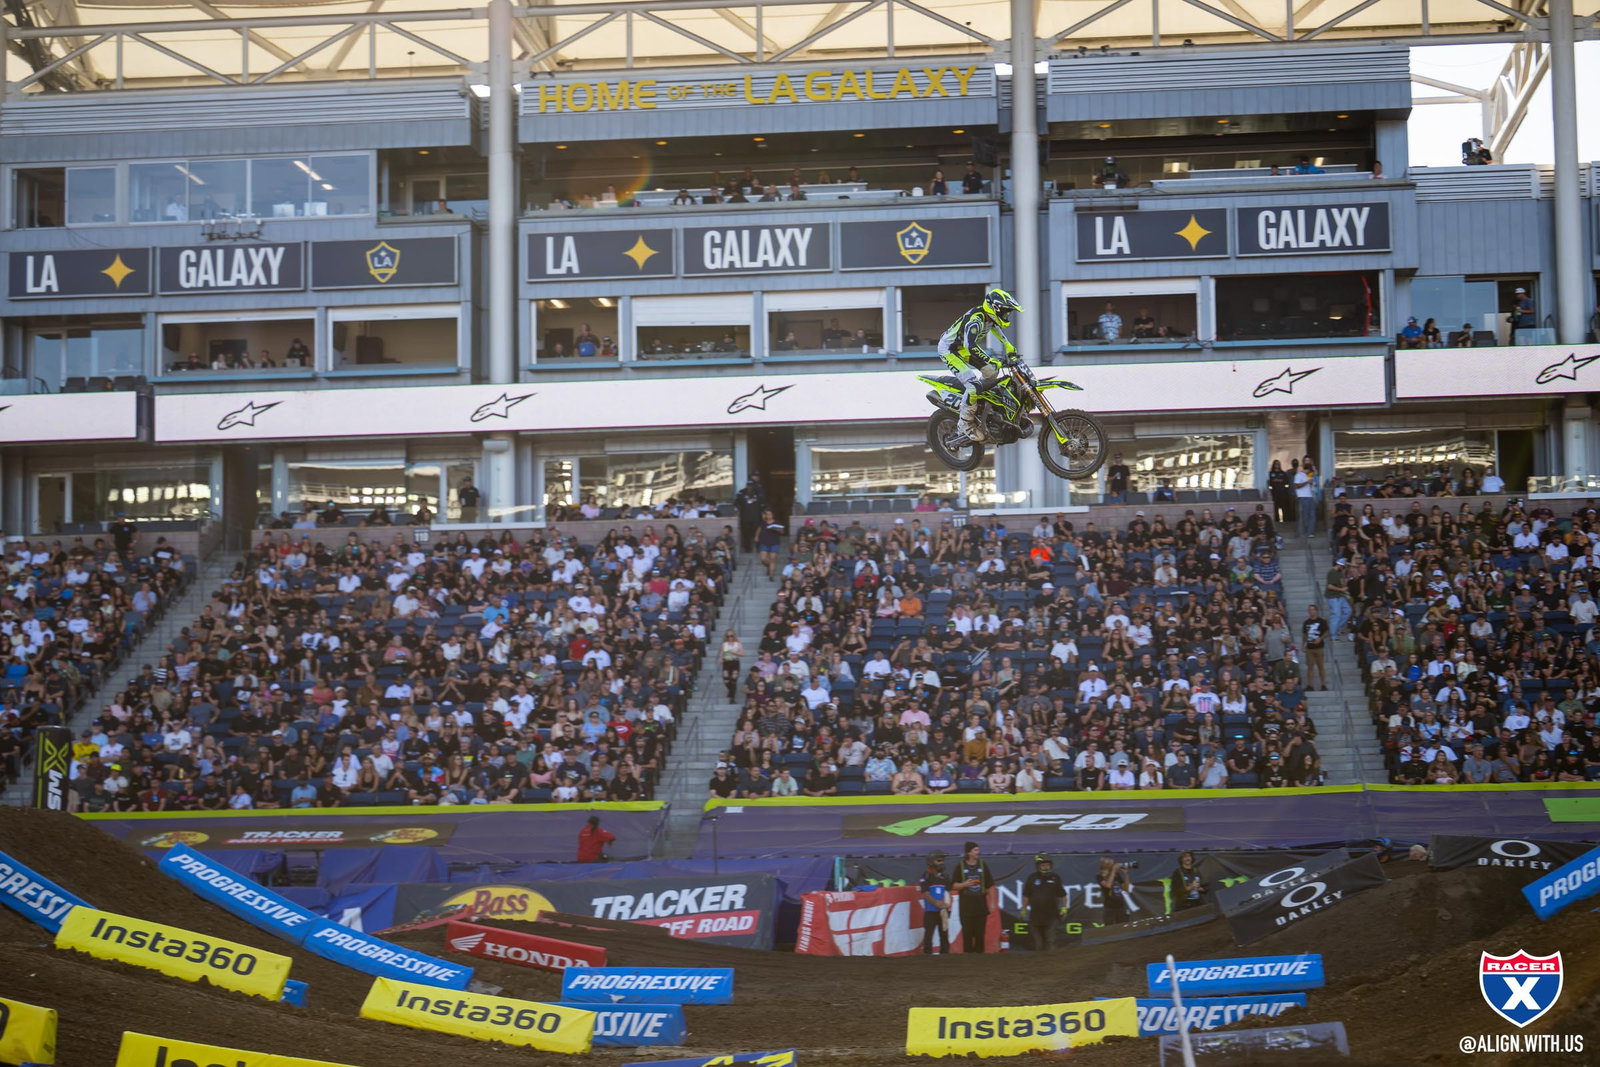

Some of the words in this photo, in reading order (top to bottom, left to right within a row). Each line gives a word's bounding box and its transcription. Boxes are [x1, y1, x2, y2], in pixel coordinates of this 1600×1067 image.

[538, 80, 657, 113] HOME
[667, 85, 695, 100] OF
[702, 83, 737, 97] THE
[743, 73, 799, 104] LA
[803, 65, 979, 102] GALAXY
[905, 237, 925, 248] LA
[1095, 216, 1131, 256] LA
[1257, 207, 1371, 250] GALAXY
[178, 247, 286, 288] GALAXY
[373, 256, 393, 267] LA
[545, 235, 580, 275] LA
[702, 227, 813, 270] GALAXY
[26, 255, 59, 293] LA
[243, 831, 344, 839] TRACKER
[924, 813, 1149, 834] UFO
[1477, 857, 1552, 870] OAKLEY
[1540, 856, 1600, 908] PROG
[169, 853, 308, 927] PROGRESSIVE
[473, 890, 529, 916] Bass
[591, 884, 748, 922] TRACKER
[1275, 890, 1344, 926] OAKLEY
[697, 916, 753, 934] ROAD
[90, 918, 257, 976] Insta360
[314, 927, 461, 982] PROGRESSIVE
[484, 941, 592, 968] HONDA
[567, 974, 724, 991] PROGRESSIVE
[1156, 961, 1311, 983] PROGRESSIVE
[396, 990, 561, 1034] Insta360
[937, 1008, 1106, 1040] Insta360
